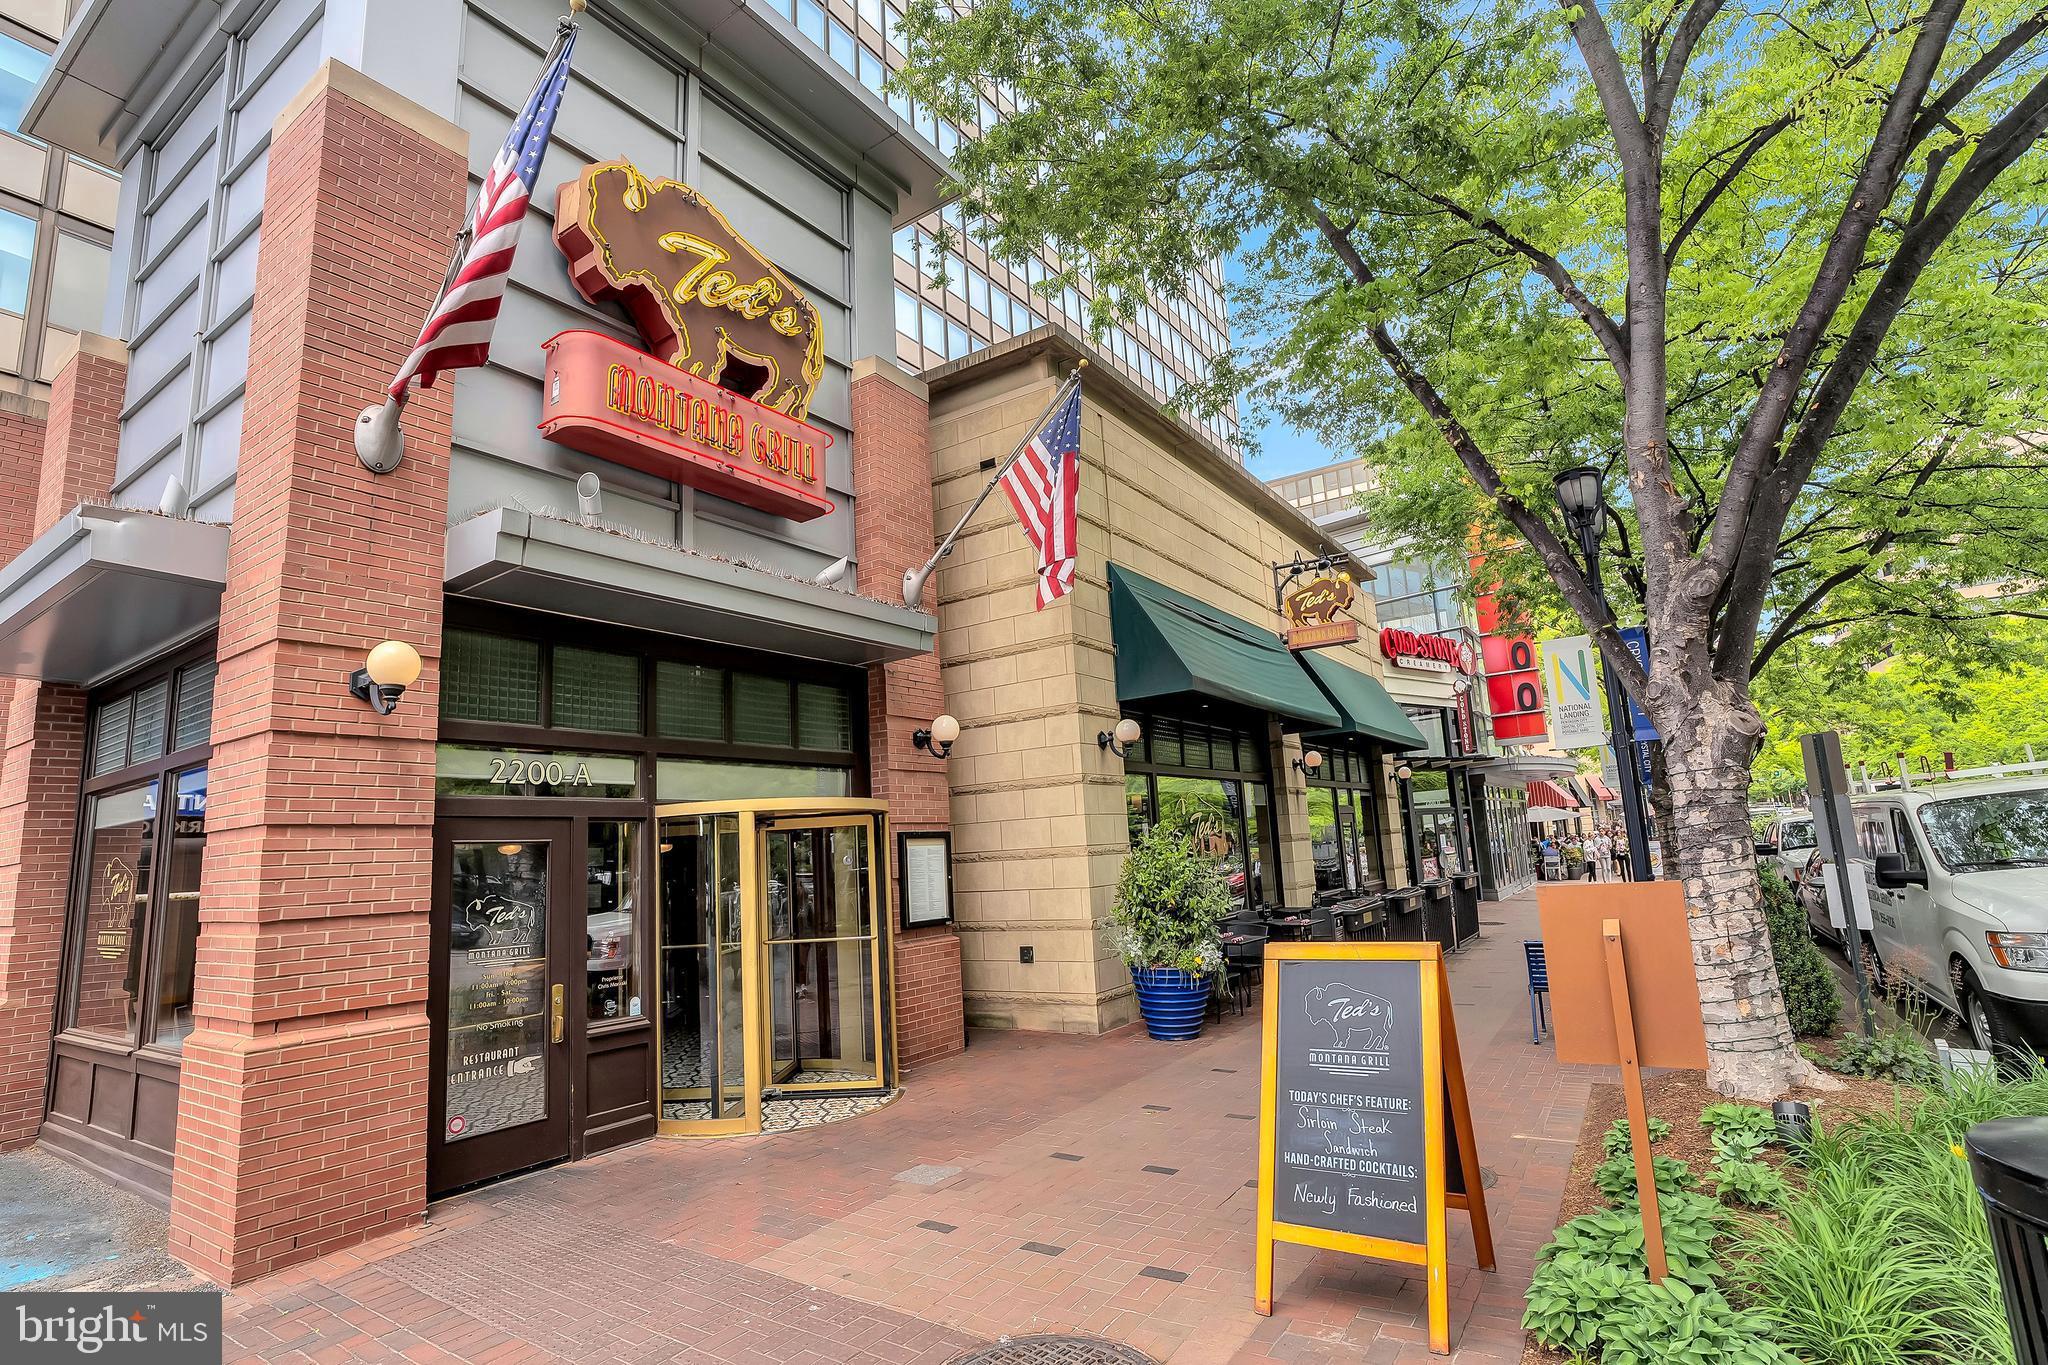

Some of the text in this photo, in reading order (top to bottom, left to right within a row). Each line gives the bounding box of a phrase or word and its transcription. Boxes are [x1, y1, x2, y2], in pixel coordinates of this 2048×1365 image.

[658, 231, 803, 337] Ted's
[607, 364, 816, 485] MONTANA GRILL
[1295, 589, 1337, 611] Ted's
[1380, 627, 1460, 668] COLD STONE
[1399, 658, 1448, 671] CREAMERY
[1558, 702, 1592, 713] NATIONAL
[1559, 710, 1590, 720] LANDING
[1462, 722, 1470, 751] STONE
[489, 757, 593, 787] 2200-A
[110, 873, 130, 901] Ted's
[486, 905, 528, 927] Ted's
[468, 946, 531, 960] MONTANA GRILL
[1327, 997, 1382, 1023] Ted's
[476, 1019, 524, 1031] No Smoking
[463, 1046, 520, 1067] RESTAURANT
[1309, 1052, 1390, 1067] MONTANA GRILL
[450, 1064, 504, 1085] ENTRANCE
[1289, 1089, 1412, 1111] TODAY'S CHEF'S FEATURE:
[1296, 1106, 1393, 1135] Sirloin Steak
[1324, 1130, 1379, 1157] Sandwich
[1284, 1152, 1418, 1179] HAND-CRAFTED COCKTAILS:
[1293, 1183, 1418, 1214] Newly Fashioned
